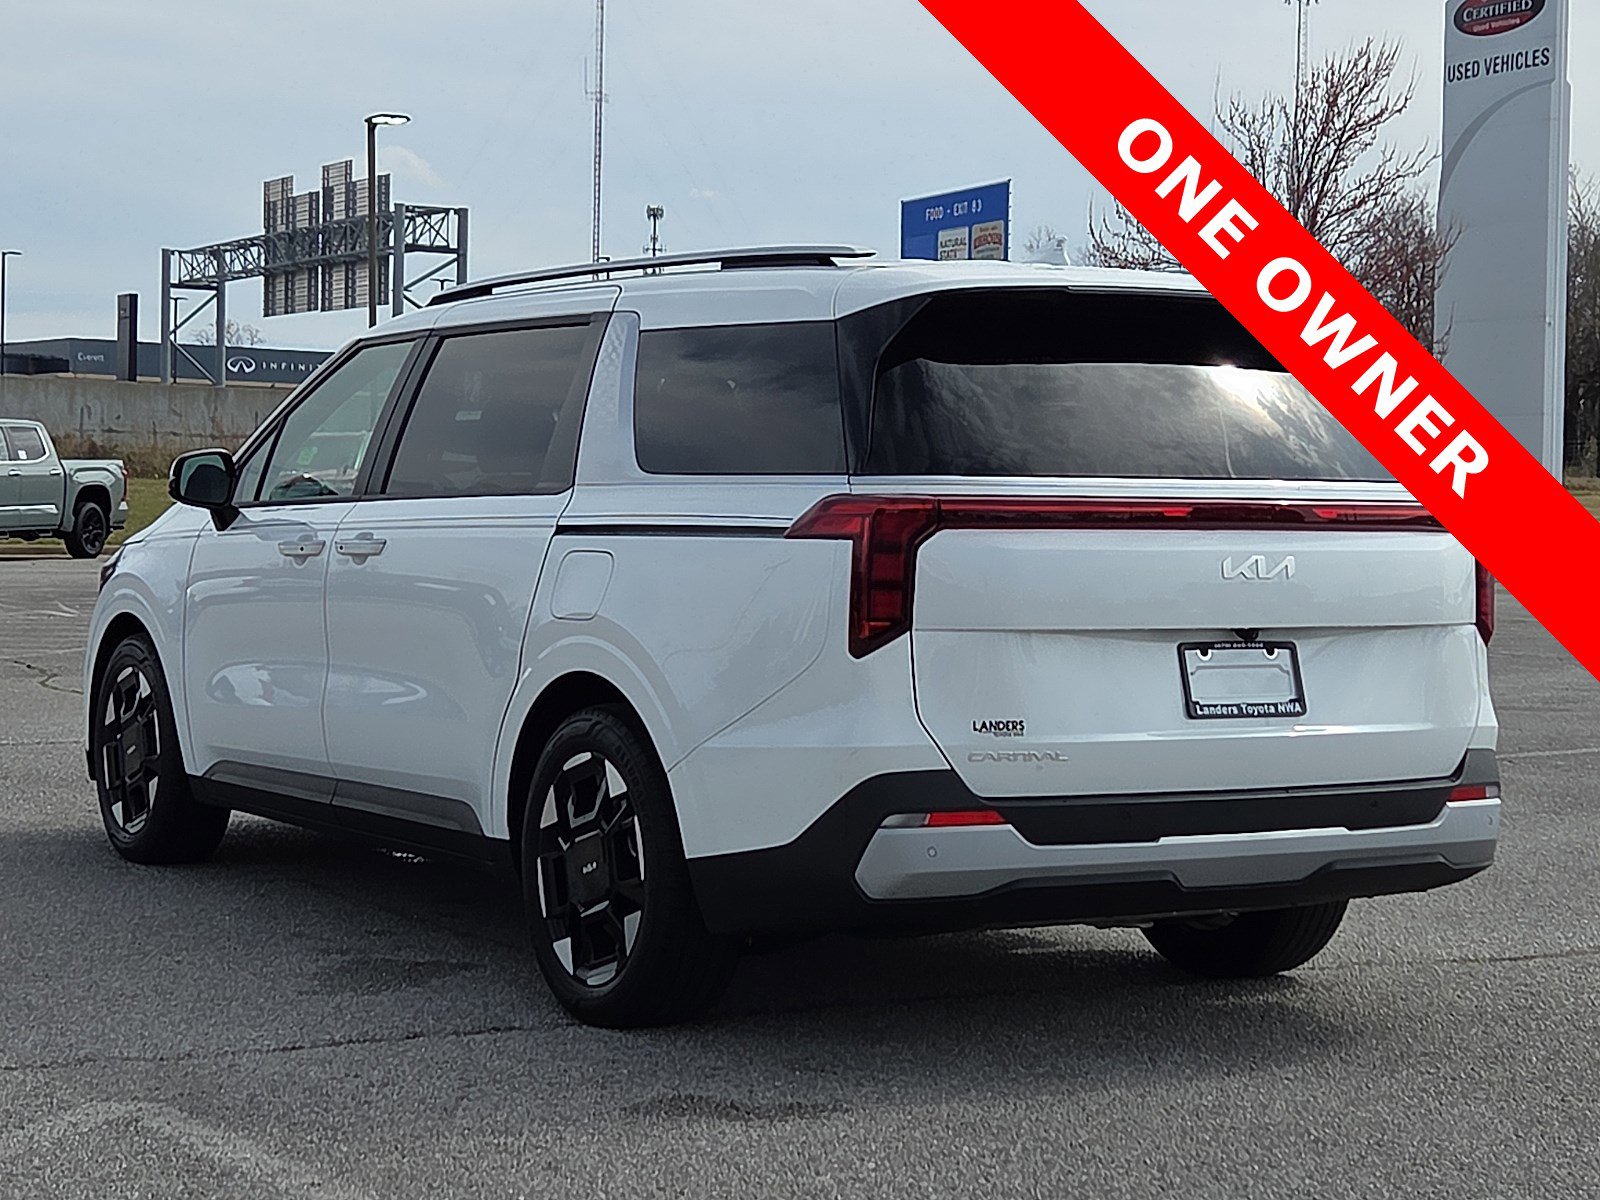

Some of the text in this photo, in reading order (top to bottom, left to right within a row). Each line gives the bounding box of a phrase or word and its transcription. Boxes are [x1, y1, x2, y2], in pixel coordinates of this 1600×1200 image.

[1463, 0, 1532, 22] CERTIFIED
[1447, 47, 1550, 83] USED VEHICLES
[926, 206, 944, 220] FOOD
[953, 201, 968, 216] EXIT
[1221, 554, 1295, 580] KIA
[1196, 701, 1302, 716] Landers Toyota NWA
[972, 720, 1025, 732] LANDERS
[967, 751, 1069, 762] CARNIVAL
